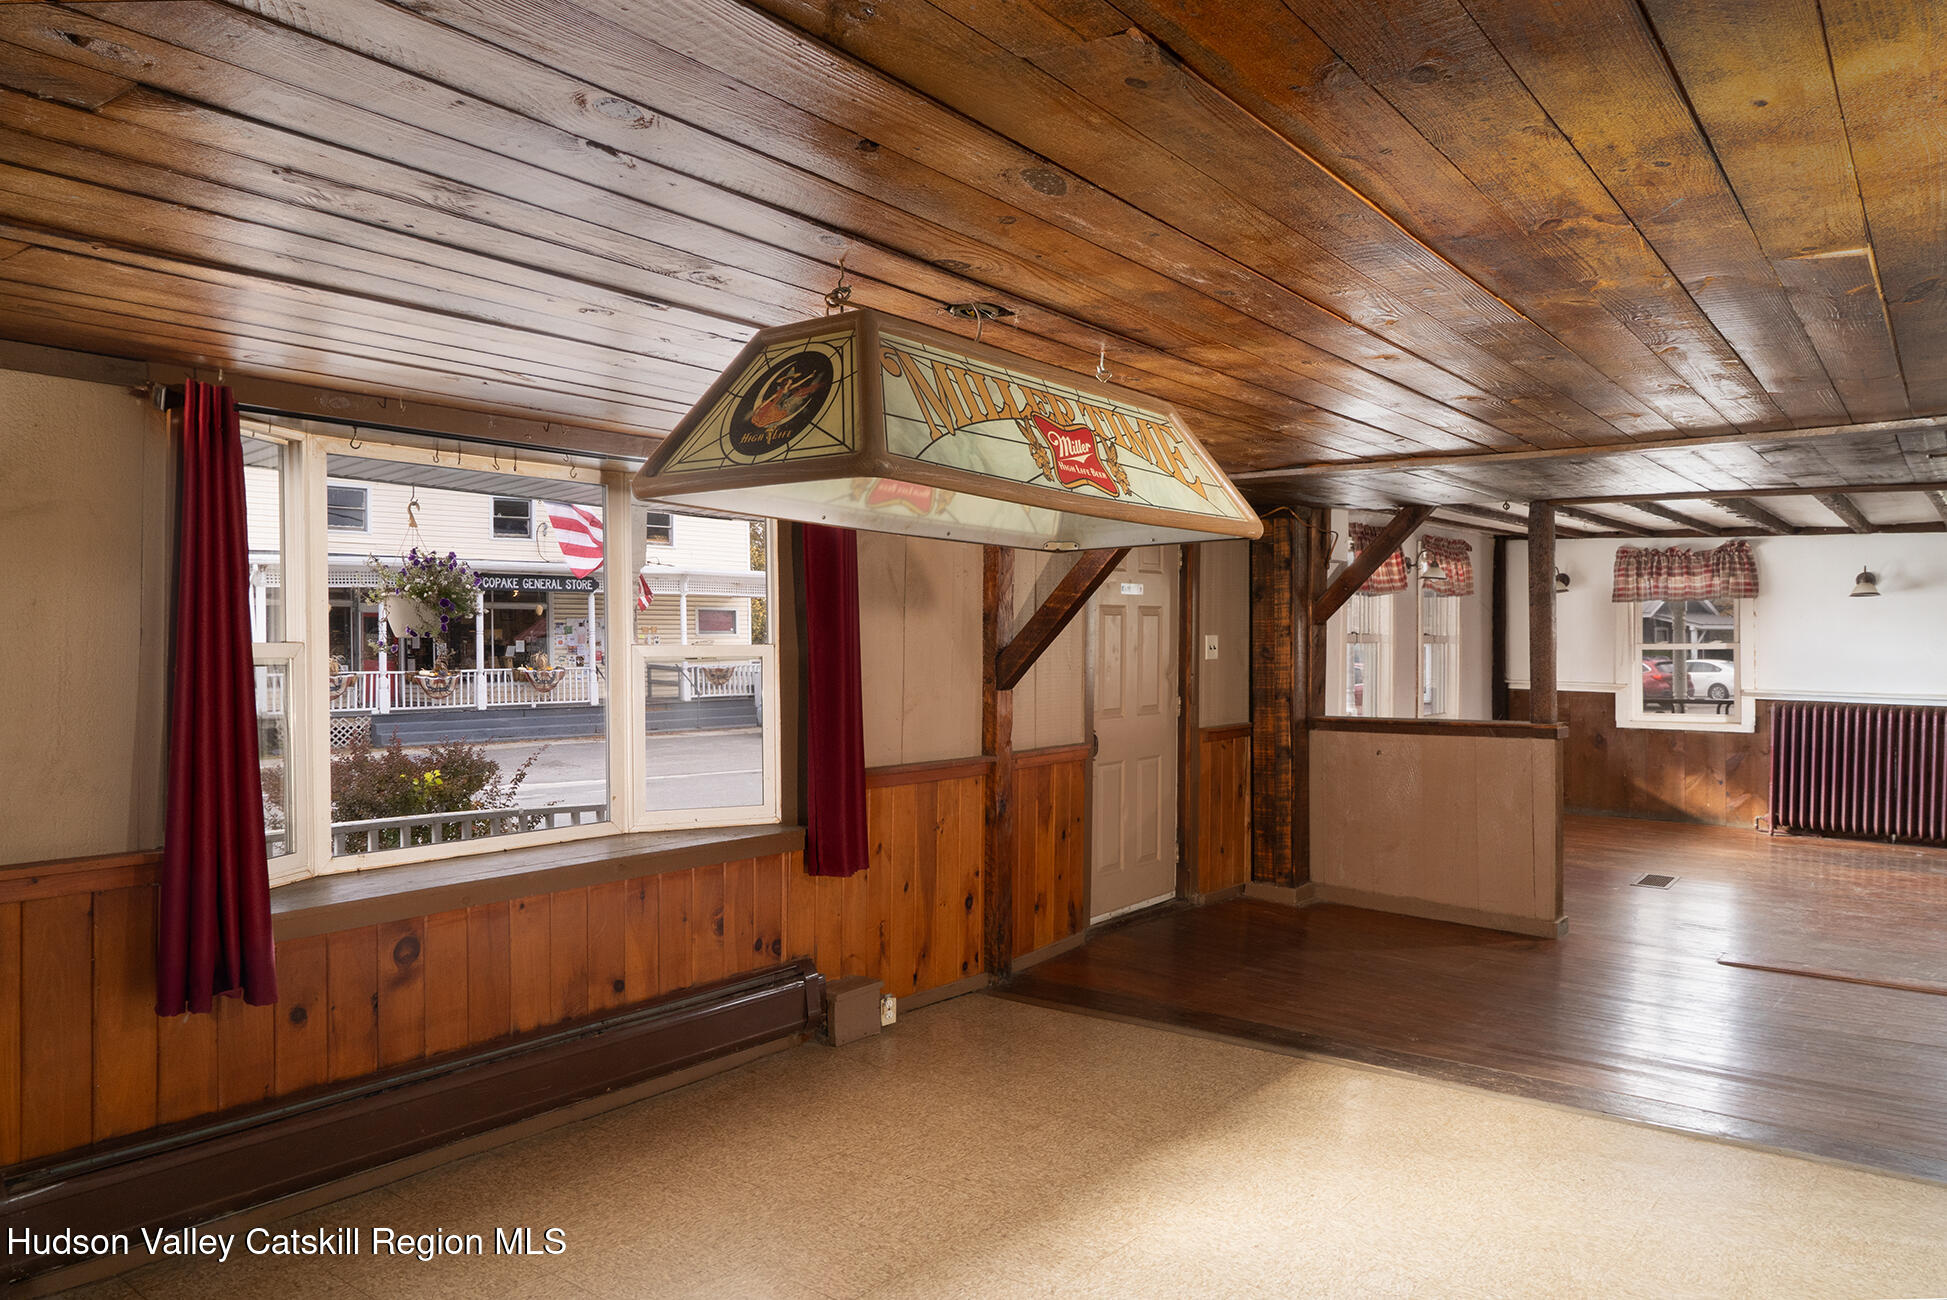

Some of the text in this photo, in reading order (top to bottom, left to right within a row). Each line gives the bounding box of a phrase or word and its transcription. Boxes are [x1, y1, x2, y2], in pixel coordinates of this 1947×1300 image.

[880, 348, 1207, 500] MILLER TIME
[741, 432, 764, 443] HIGH
[1048, 431, 1091, 457] Miller
[1058, 461, 1076, 473] HIGH
[1075, 464, 1091, 476] LIFE
[482, 576, 593, 590] COPAKE GENERAL STORE
